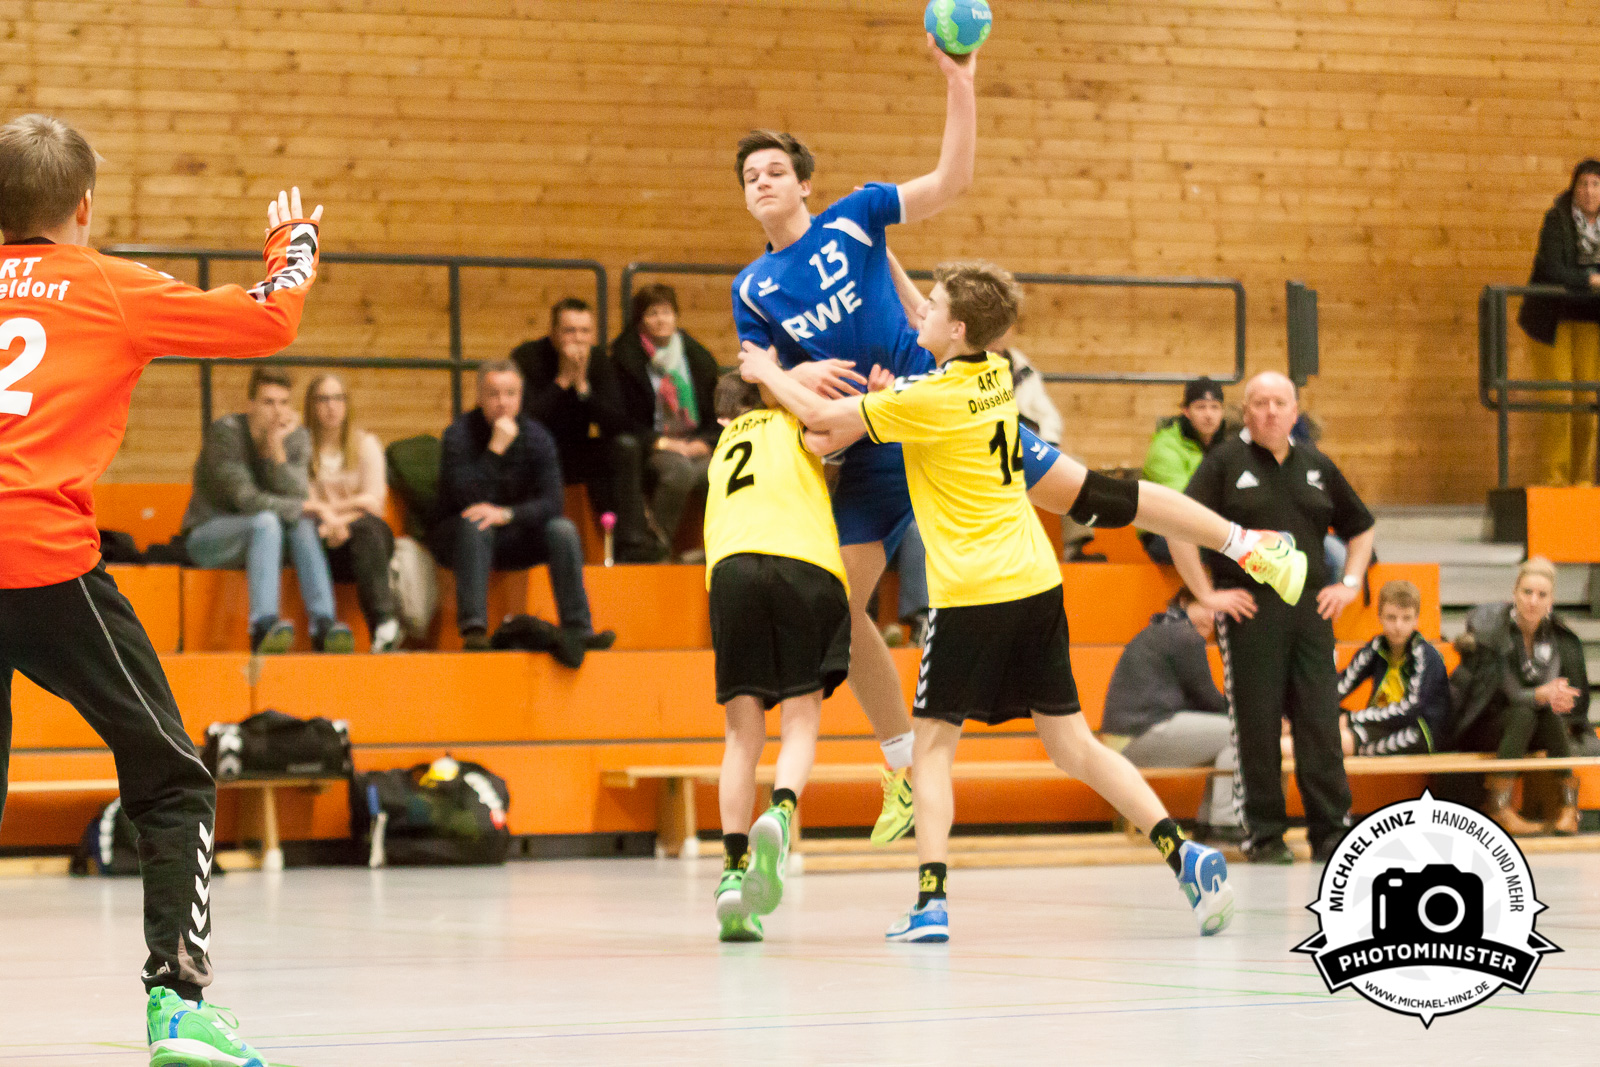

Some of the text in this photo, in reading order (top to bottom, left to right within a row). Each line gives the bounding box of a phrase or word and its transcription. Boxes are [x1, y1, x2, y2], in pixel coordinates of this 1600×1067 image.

[0, 277, 71, 301] eldorf
[809, 240, 849, 291] 13
[781, 280, 863, 342] RWE
[0, 317, 47, 417] 2
[977, 369, 1001, 393] ART
[723, 440, 755, 499] 2
